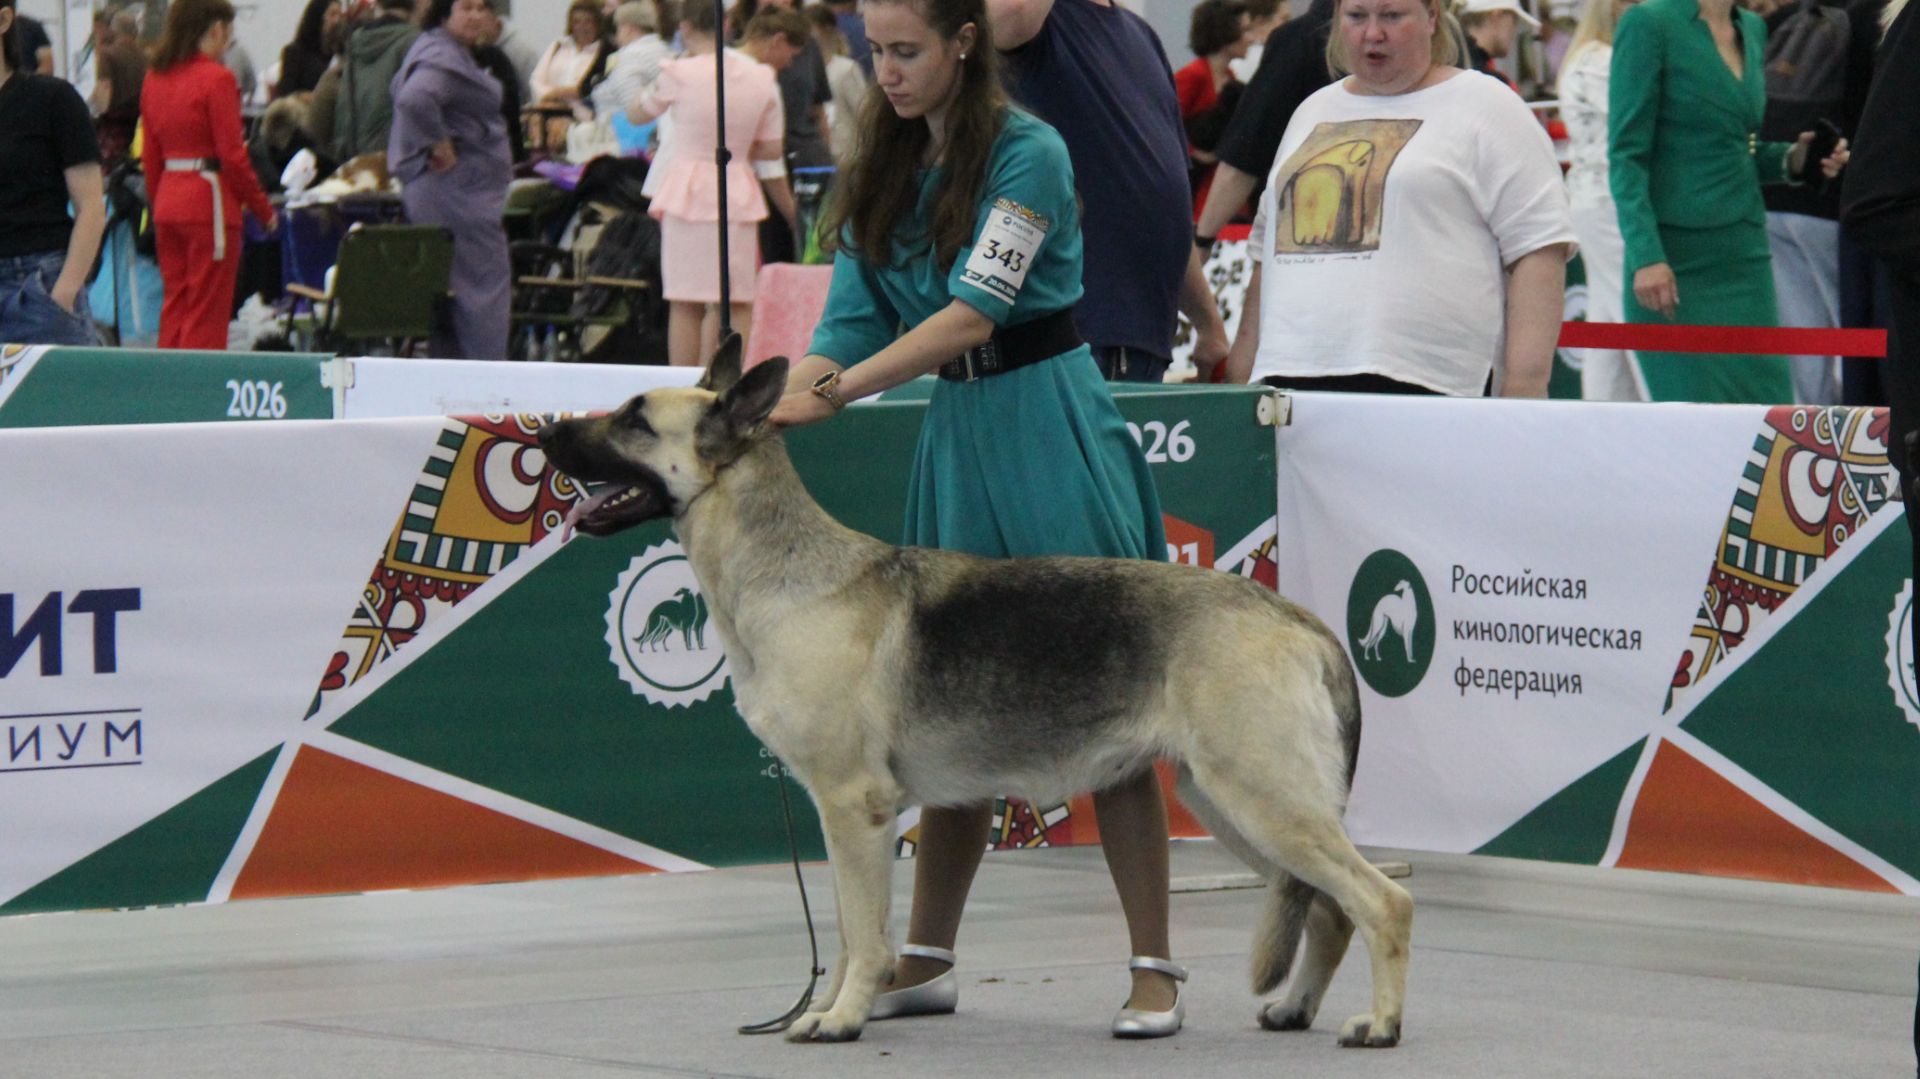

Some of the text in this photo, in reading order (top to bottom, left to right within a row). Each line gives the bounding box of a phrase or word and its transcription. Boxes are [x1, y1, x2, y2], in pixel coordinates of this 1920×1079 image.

[982, 238, 1025, 273] 343
[225, 379, 287, 418] 2026
[1451, 564, 1588, 600] Российская
[1453, 619, 1643, 651] кинологическая
[1453, 656, 1584, 701] федерация
